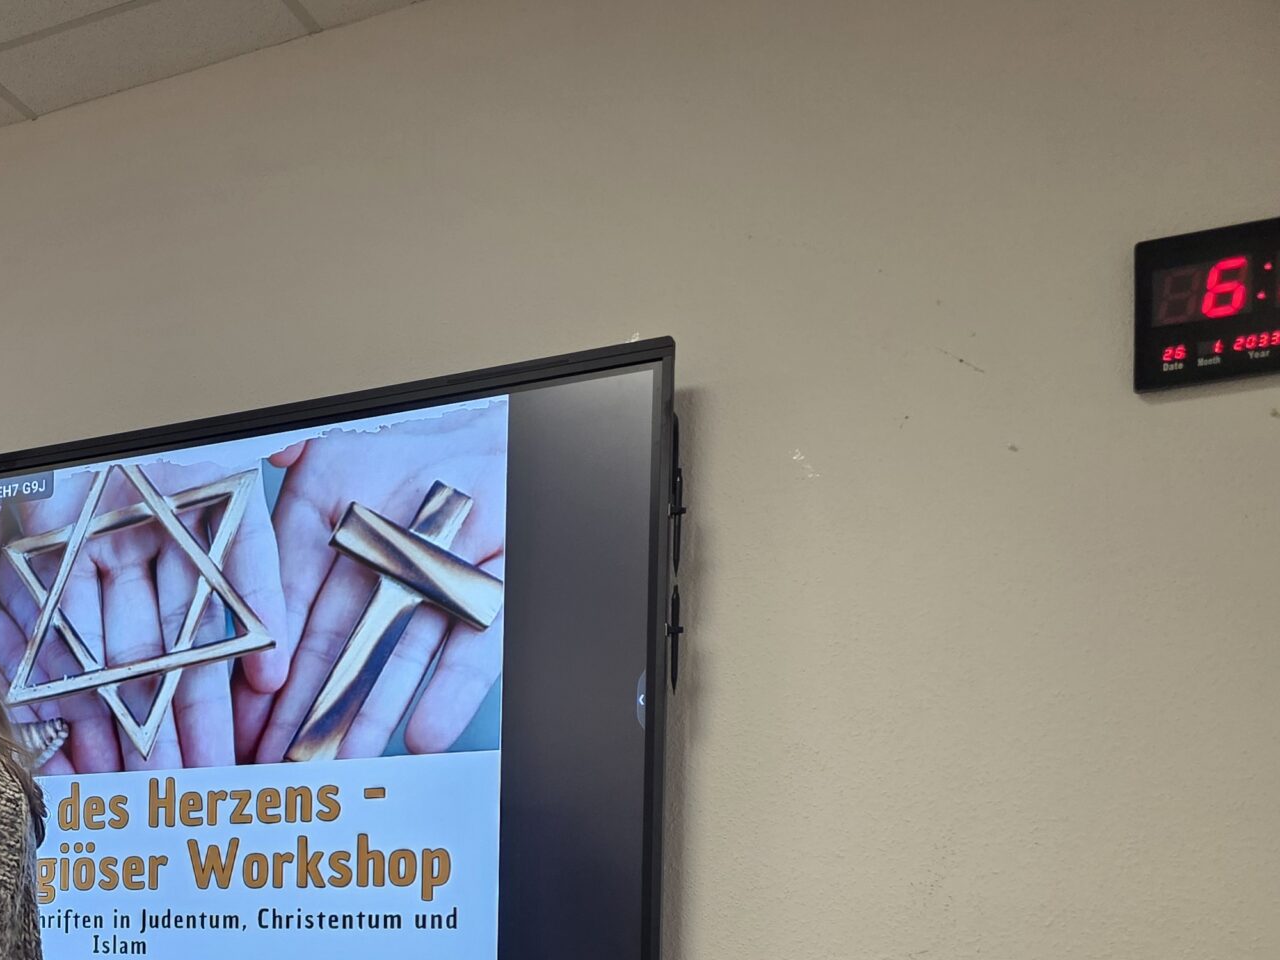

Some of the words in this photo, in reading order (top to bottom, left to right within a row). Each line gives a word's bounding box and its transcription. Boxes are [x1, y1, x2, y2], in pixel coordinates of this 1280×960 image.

[1163, 363, 1184, 371] Date
[1197, 357, 1221, 366] Month
[1248, 351, 1270, 359] Year
[22, 480, 46, 494] G9J
[57, 781, 129, 831] des
[148, 776, 342, 828] Herzens
[37, 842, 168, 904] giöser
[186, 833, 452, 901] Workshop
[113, 909, 130, 929] in
[140, 908, 247, 934] Judentum,
[257, 907, 403, 930] Christentum
[414, 906, 458, 929] und
[93, 934, 147, 955] Islam
